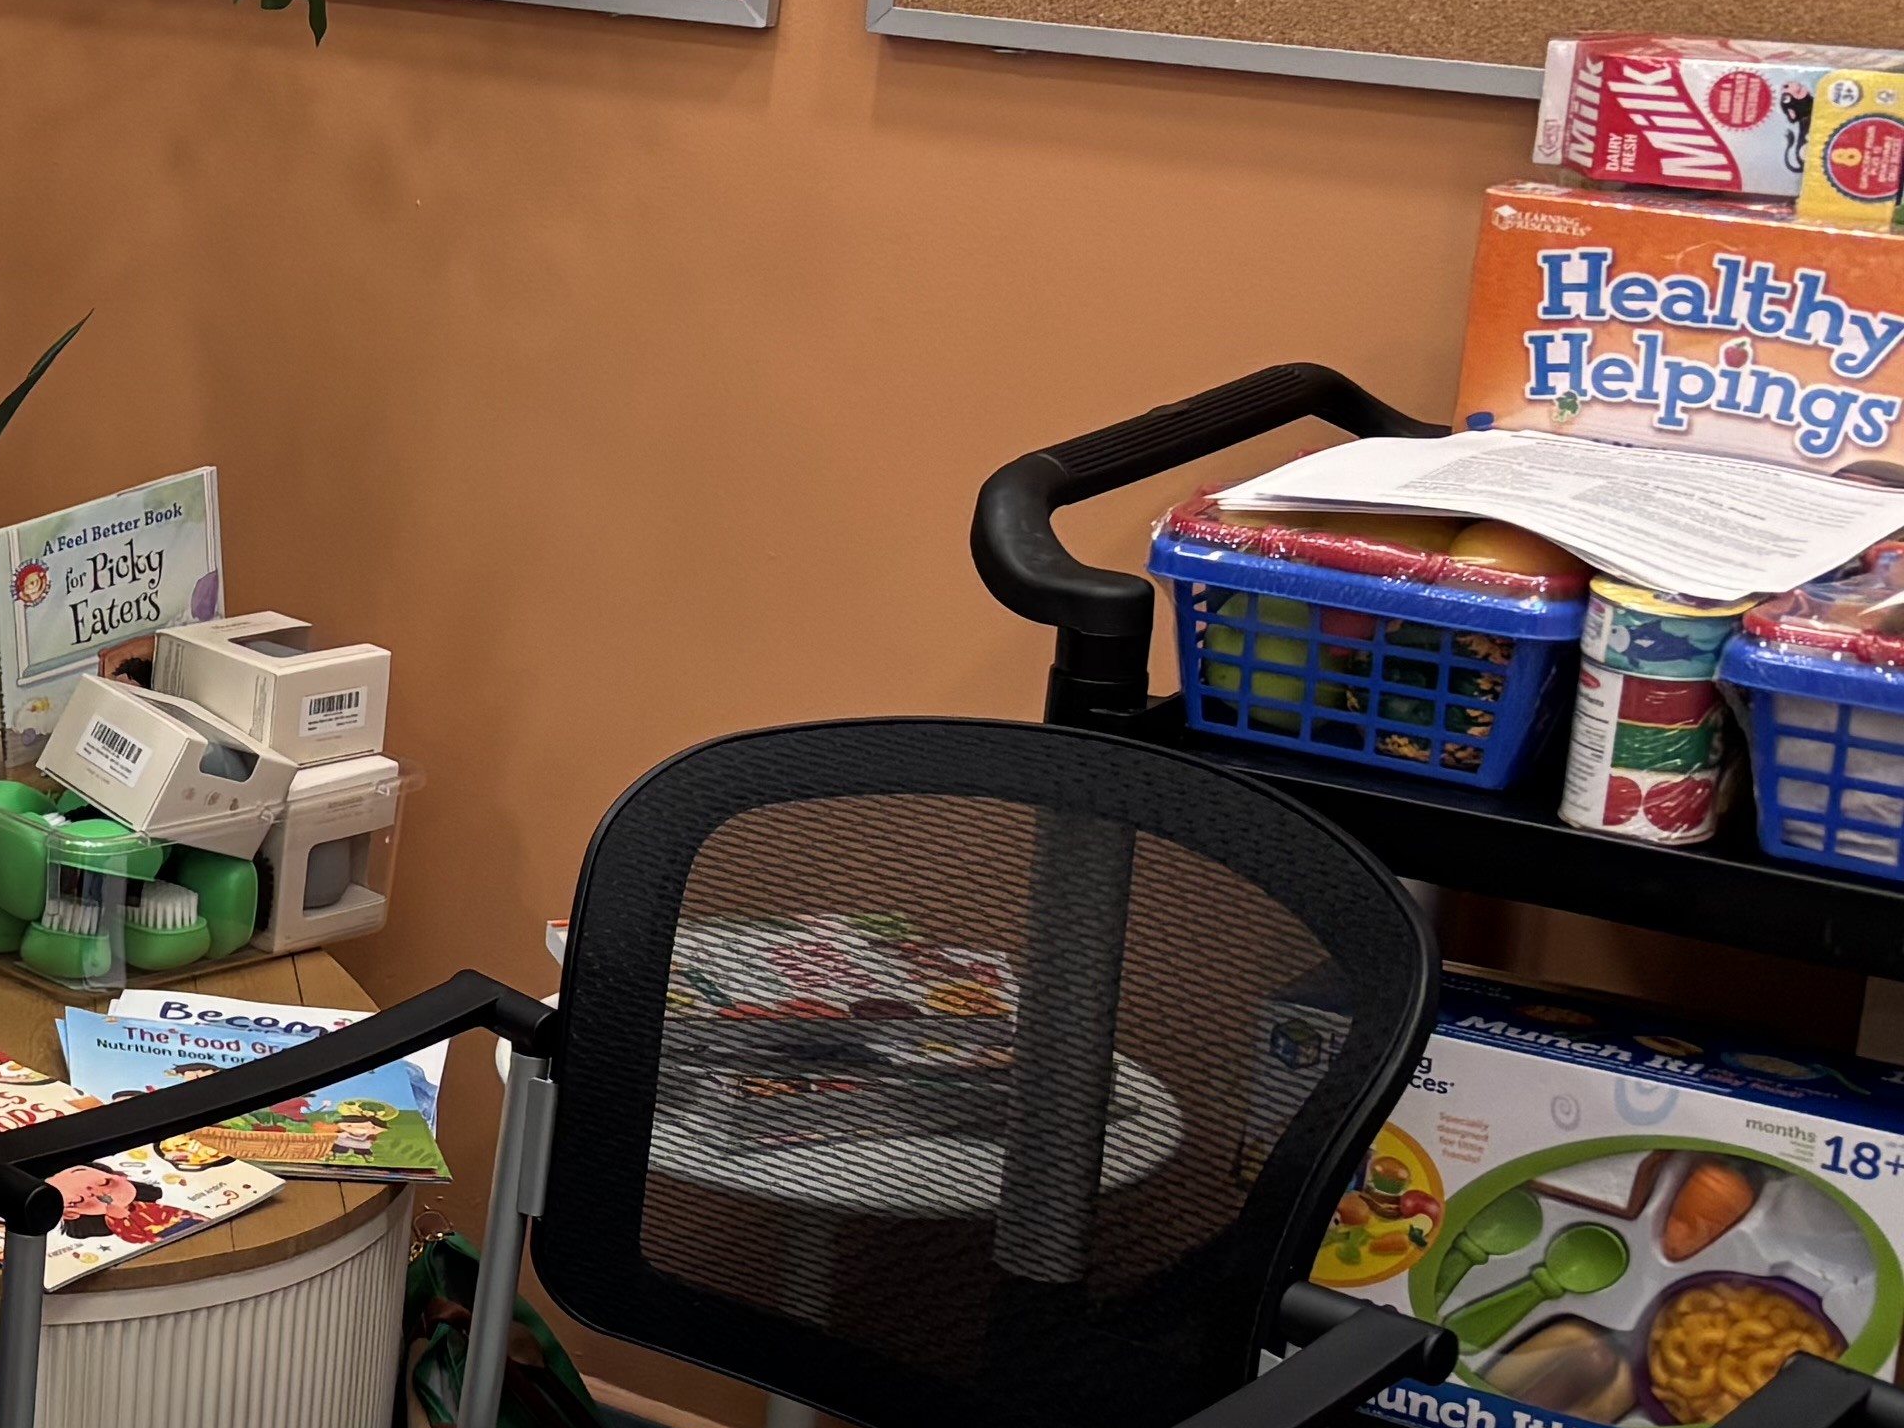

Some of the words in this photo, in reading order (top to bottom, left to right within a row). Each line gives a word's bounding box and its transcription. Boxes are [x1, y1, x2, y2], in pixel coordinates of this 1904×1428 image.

[1569, 56, 1604, 168] Milk
[1607, 58, 1733, 181] Milk
[1605, 132, 1622, 171] DAIRY
[1621, 134, 1638, 172] FRESH
[1831, 147, 1863, 167] 8
[1539, 249, 1904, 376] Healthy
[1526, 332, 1900, 456] Helpings
[43, 540, 55, 557] A
[57, 528, 88, 552] Feel
[92, 516, 141, 542] Better
[144, 502, 183, 527] Book
[65, 566, 87, 595] for
[87, 538, 165, 594] Picky
[69, 589, 161, 646] Eaters
[96, 1038, 173, 1057] Nutrition
[178, 1049, 216, 1063] Book
[221, 1054, 247, 1065] For
[125, 1026, 170, 1044] The
[179, 1032, 242, 1053] Food
[1456, 1014, 1633, 1063] Munch
[1642, 1053, 1705, 1077] It!
[1745, 1117, 1818, 1143] months
[1820, 1135, 1904, 1180] 18+
